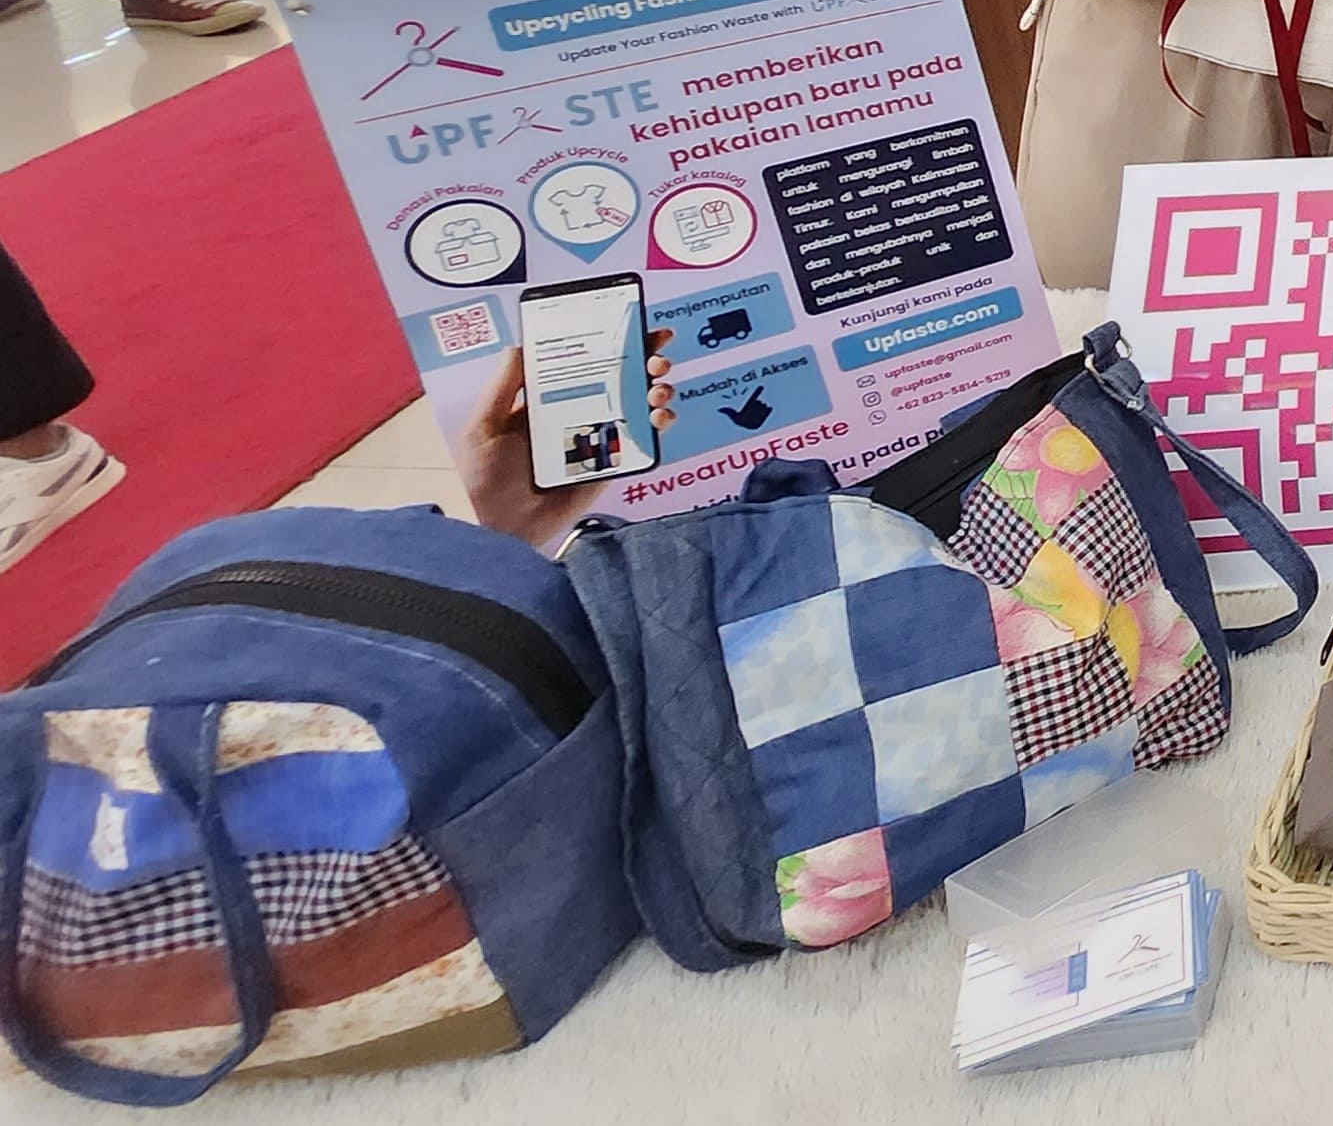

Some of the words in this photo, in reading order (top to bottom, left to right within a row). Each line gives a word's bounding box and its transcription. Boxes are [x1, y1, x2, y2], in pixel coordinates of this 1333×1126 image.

[558, 41, 617, 63] Update
[619, 35, 656, 51] Your
[659, 21, 719, 43] Fashion
[721, 12, 769, 31] Waste
[771, 4, 804, 21] with
[681, 37, 884, 97] memberikan
[630, 89, 803, 144] kehidupan
[810, 74, 882, 106] baru
[888, 52, 964, 98] pada
[669, 119, 801, 171] pakaian
[807, 89, 935, 134] lamamu
[776, 160, 831, 182] platform
[844, 148, 878, 165] yang
[890, 126, 969, 152] berkomitmen
[516, 148, 564, 187] Produk
[566, 146, 629, 164] Upcycle
[647, 172, 690, 200] Tukar
[692, 169, 748, 187] katalog
[782, 181, 819, 198] untuk
[838, 156, 914, 184] mengurangi
[787, 197, 834, 216] fashion
[840, 191, 853, 202] di
[859, 179, 906, 198] wilayah
[911, 160, 979, 185] Kalimantan
[386, 189, 432, 233] Donasi
[435, 184, 505, 198] Pakaian
[793, 218, 834, 234] Timur.
[845, 204, 878, 221] Kami
[891, 178, 984, 209] mengumpulkan
[799, 232, 850, 255] pakaian
[853, 221, 892, 238] bekas
[894, 203, 961, 227] berkualitas
[962, 194, 990, 208] baik
[804, 256, 831, 270] dan
[845, 229, 933, 259] mengubahnya
[946, 211, 994, 232] menjadi
[811, 256, 903, 290] produk-produk
[925, 242, 952, 256] unik
[975, 228, 999, 242] dan
[653, 281, 771, 323] Penjemputan
[815, 276, 902, 306] berkelanjutan.
[840, 298, 910, 328] Kunjungi
[912, 287, 952, 306] kami
[955, 276, 993, 297] pada
[864, 301, 999, 353] Upfaste.com
[679, 376, 739, 402] Mudah
[741, 369, 759, 385] di
[761, 355, 809, 379] Akses
[884, 333, 1013, 382] upfaste@gmail.com
[891, 370, 952, 397] @upfaste
[896, 398, 919, 411] +62
[623, 420, 850, 505] #wearUpFaste
[862, 432, 921, 464] pada
